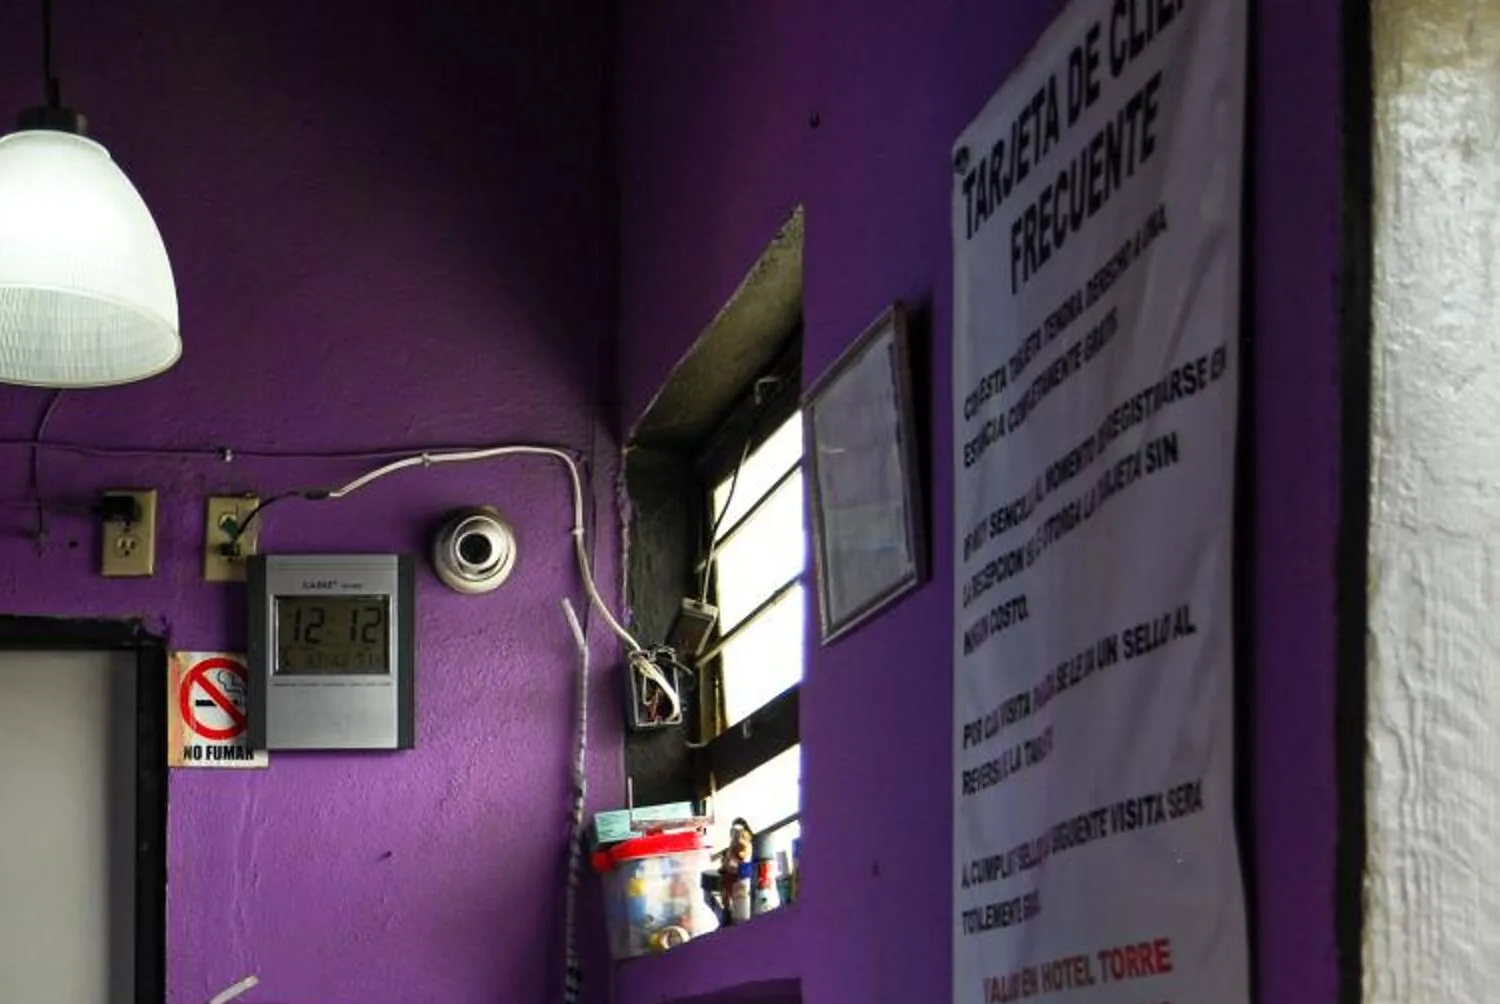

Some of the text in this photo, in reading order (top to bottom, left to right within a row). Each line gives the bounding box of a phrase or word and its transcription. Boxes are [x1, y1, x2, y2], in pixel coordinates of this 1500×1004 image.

[962, 74, 1060, 241] TARJETA
[1067, 20, 1101, 129] DE
[1011, 70, 1162, 295] FRECUENTE
[1145, 431, 1179, 475] SIN
[1122, 613, 1172, 660] SELLO
[1173, 603, 1197, 640] AL
[184, 745, 202, 760] NO
[1111, 793, 1167, 833] VISITA
[1041, 955, 1095, 993] HOTEL
[1098, 937, 1173, 984] TORRE
